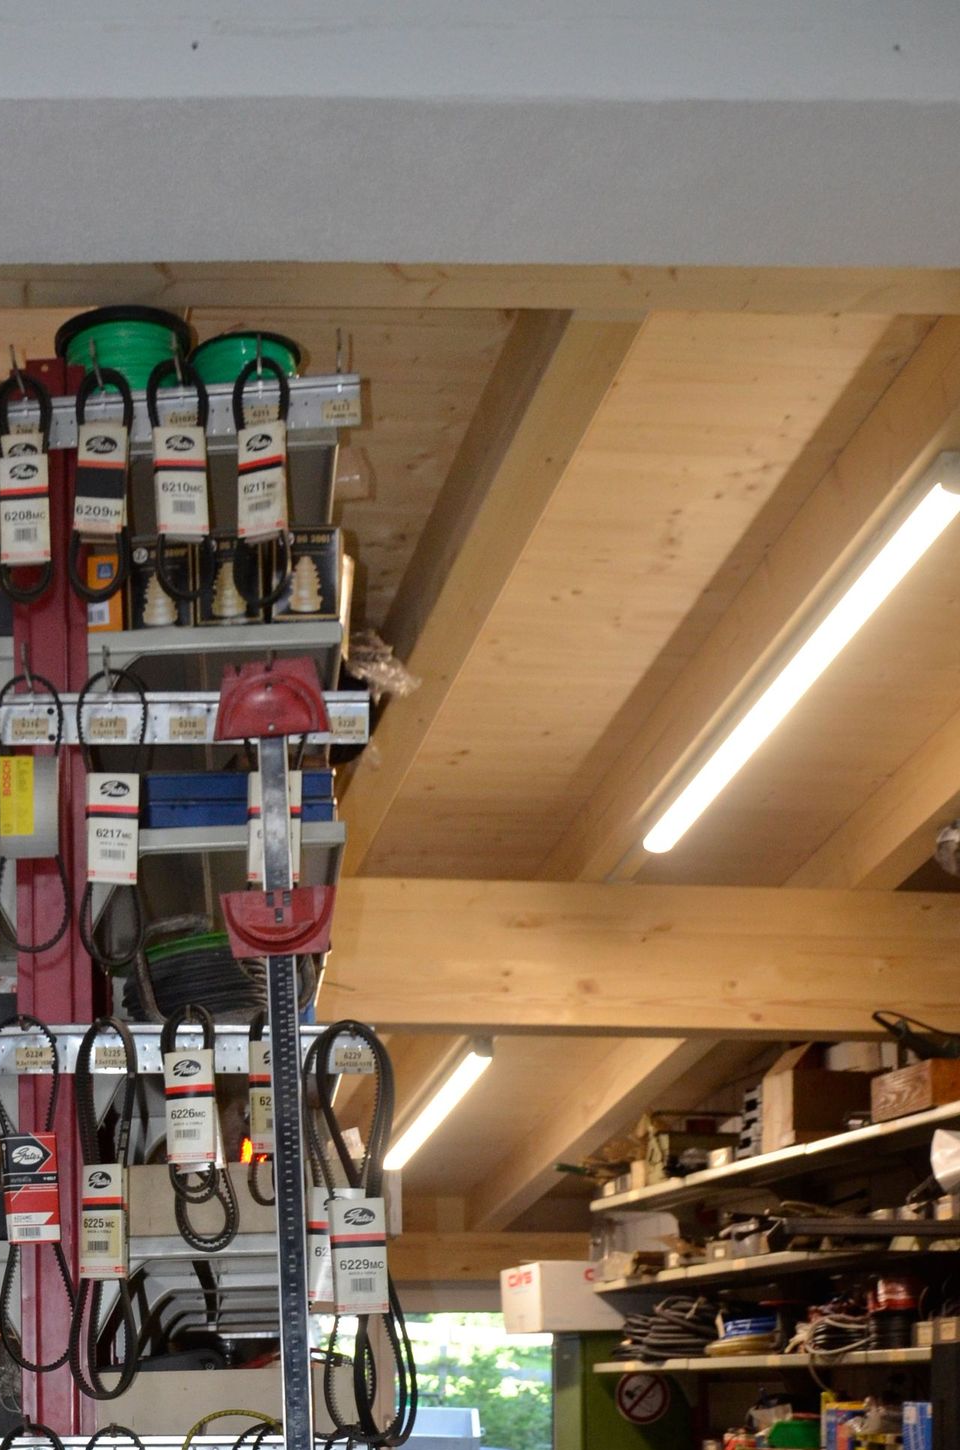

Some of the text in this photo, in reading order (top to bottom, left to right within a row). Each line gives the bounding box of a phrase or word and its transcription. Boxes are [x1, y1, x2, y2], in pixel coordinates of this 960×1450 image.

[2, 760, 11, 796] BOSCH
[96, 829, 132, 839] 6217MC
[173, 1060, 201, 1077] Gates
[171, 1109, 206, 1119] 6226MC
[12, 1146, 44, 1164] Gates
[88, 1171, 112, 1188] Gates
[83, 1218, 104, 1228] 6225
[344, 1208, 376, 1226] Gates
[340, 1260, 384, 1270] 6229MC
